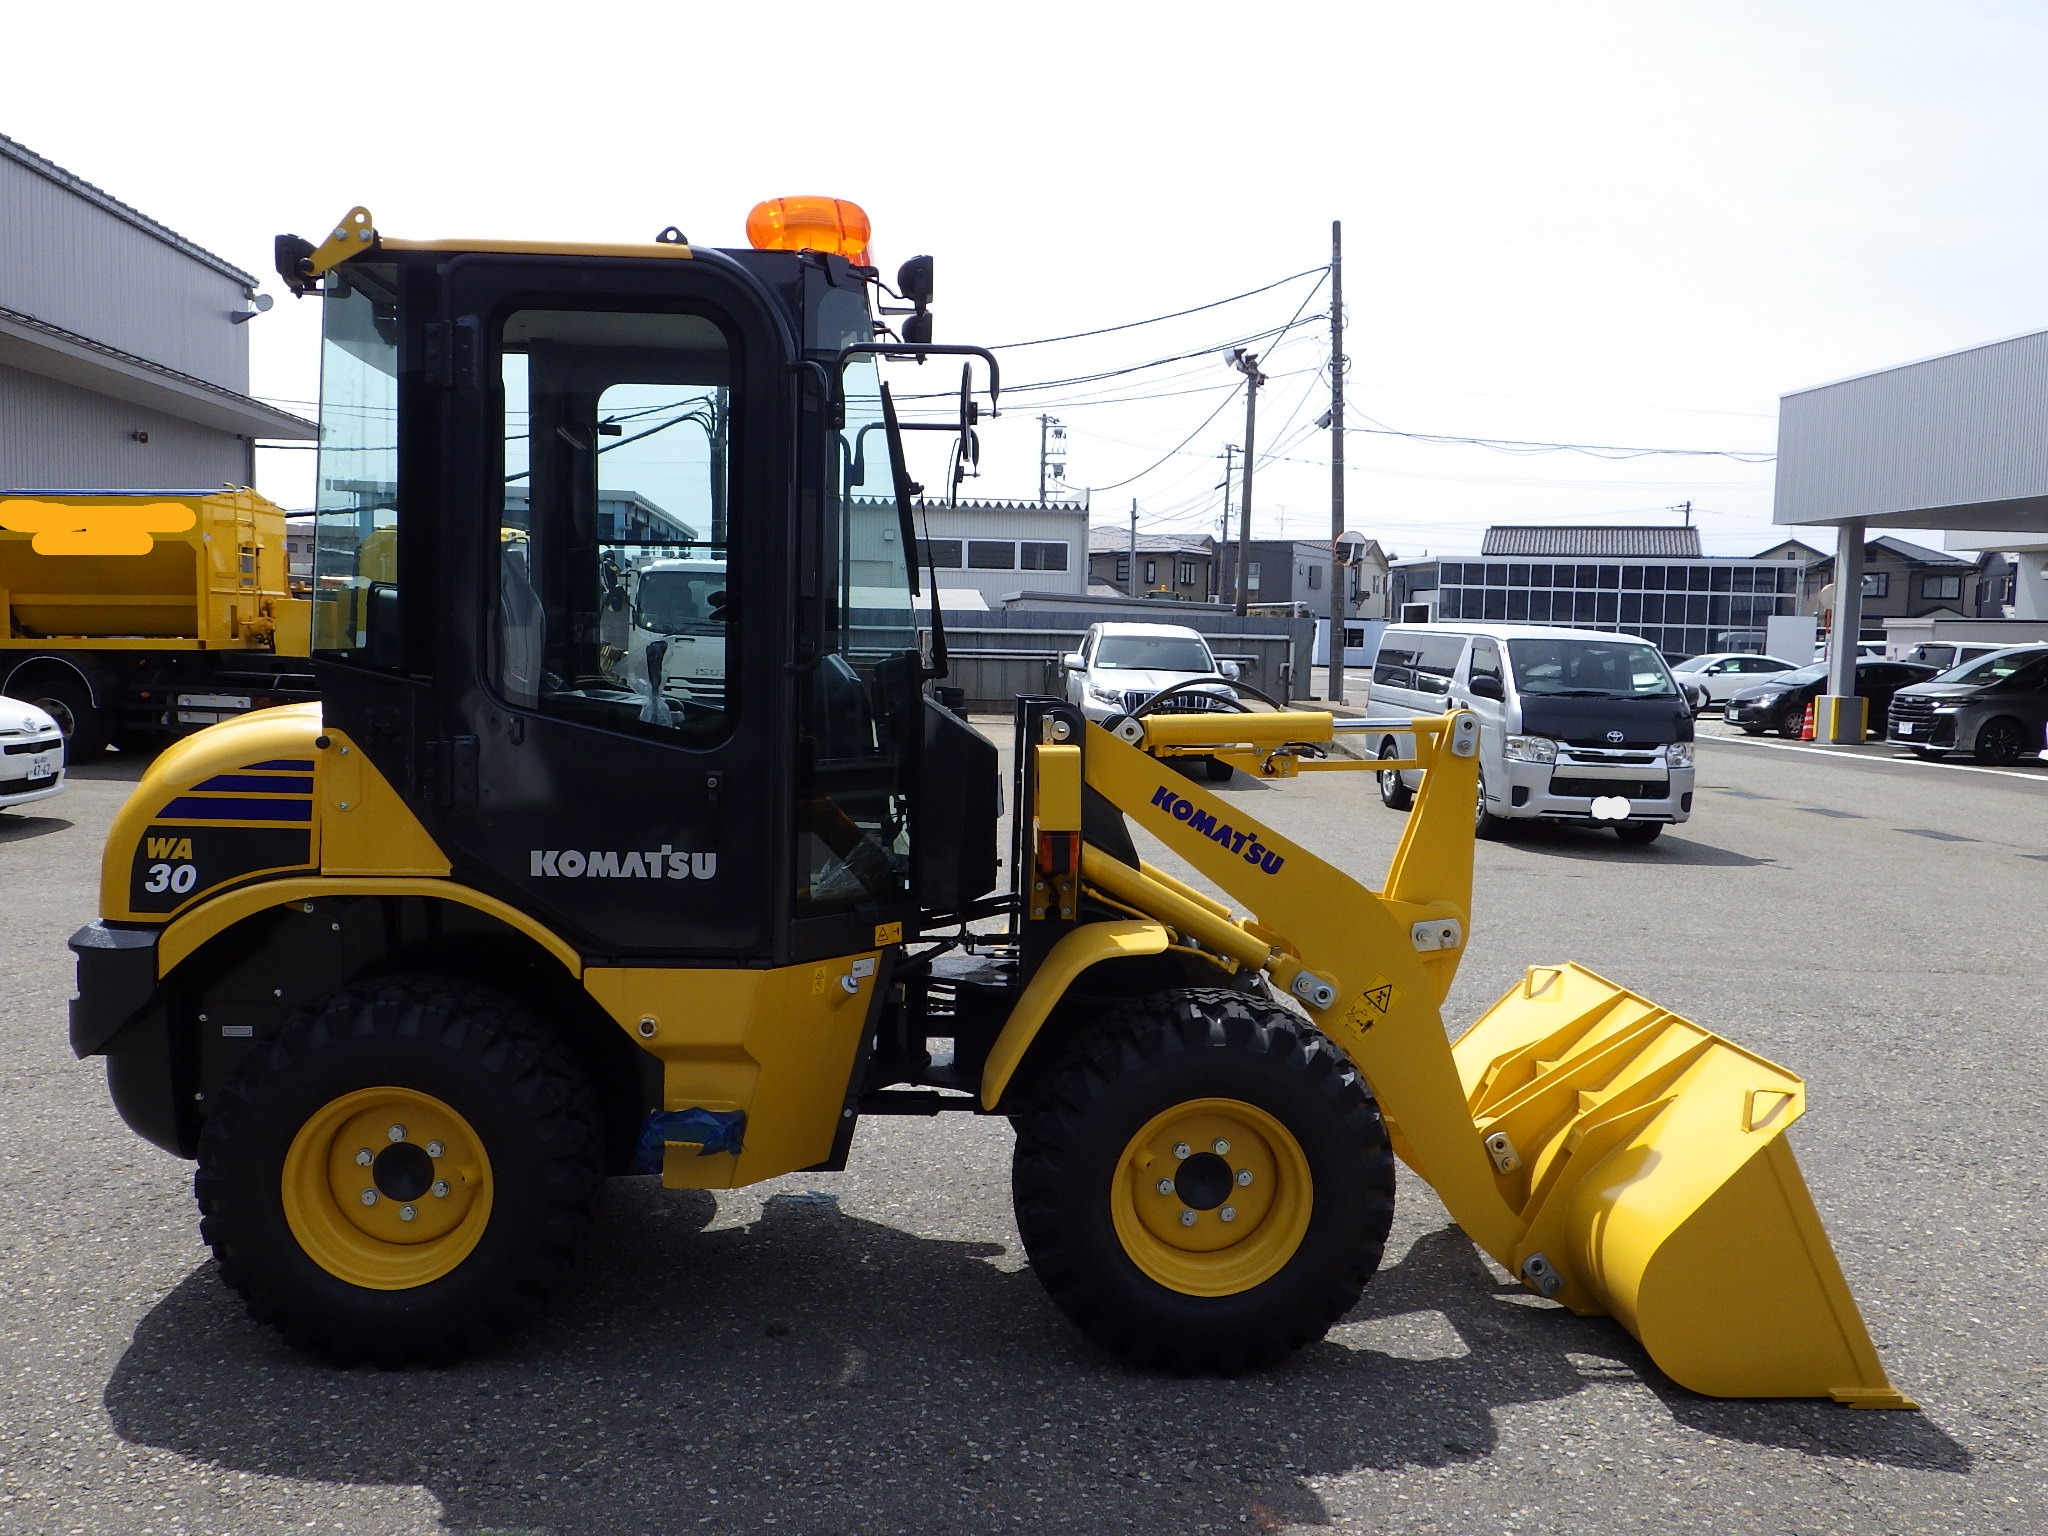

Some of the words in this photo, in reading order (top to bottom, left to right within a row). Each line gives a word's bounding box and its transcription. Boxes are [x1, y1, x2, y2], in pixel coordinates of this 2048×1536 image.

[1150, 785, 1285, 875] KOMATSU
[147, 837, 193, 859] WA
[530, 844, 717, 880] KOMATSU
[145, 863, 197, 893] 30
